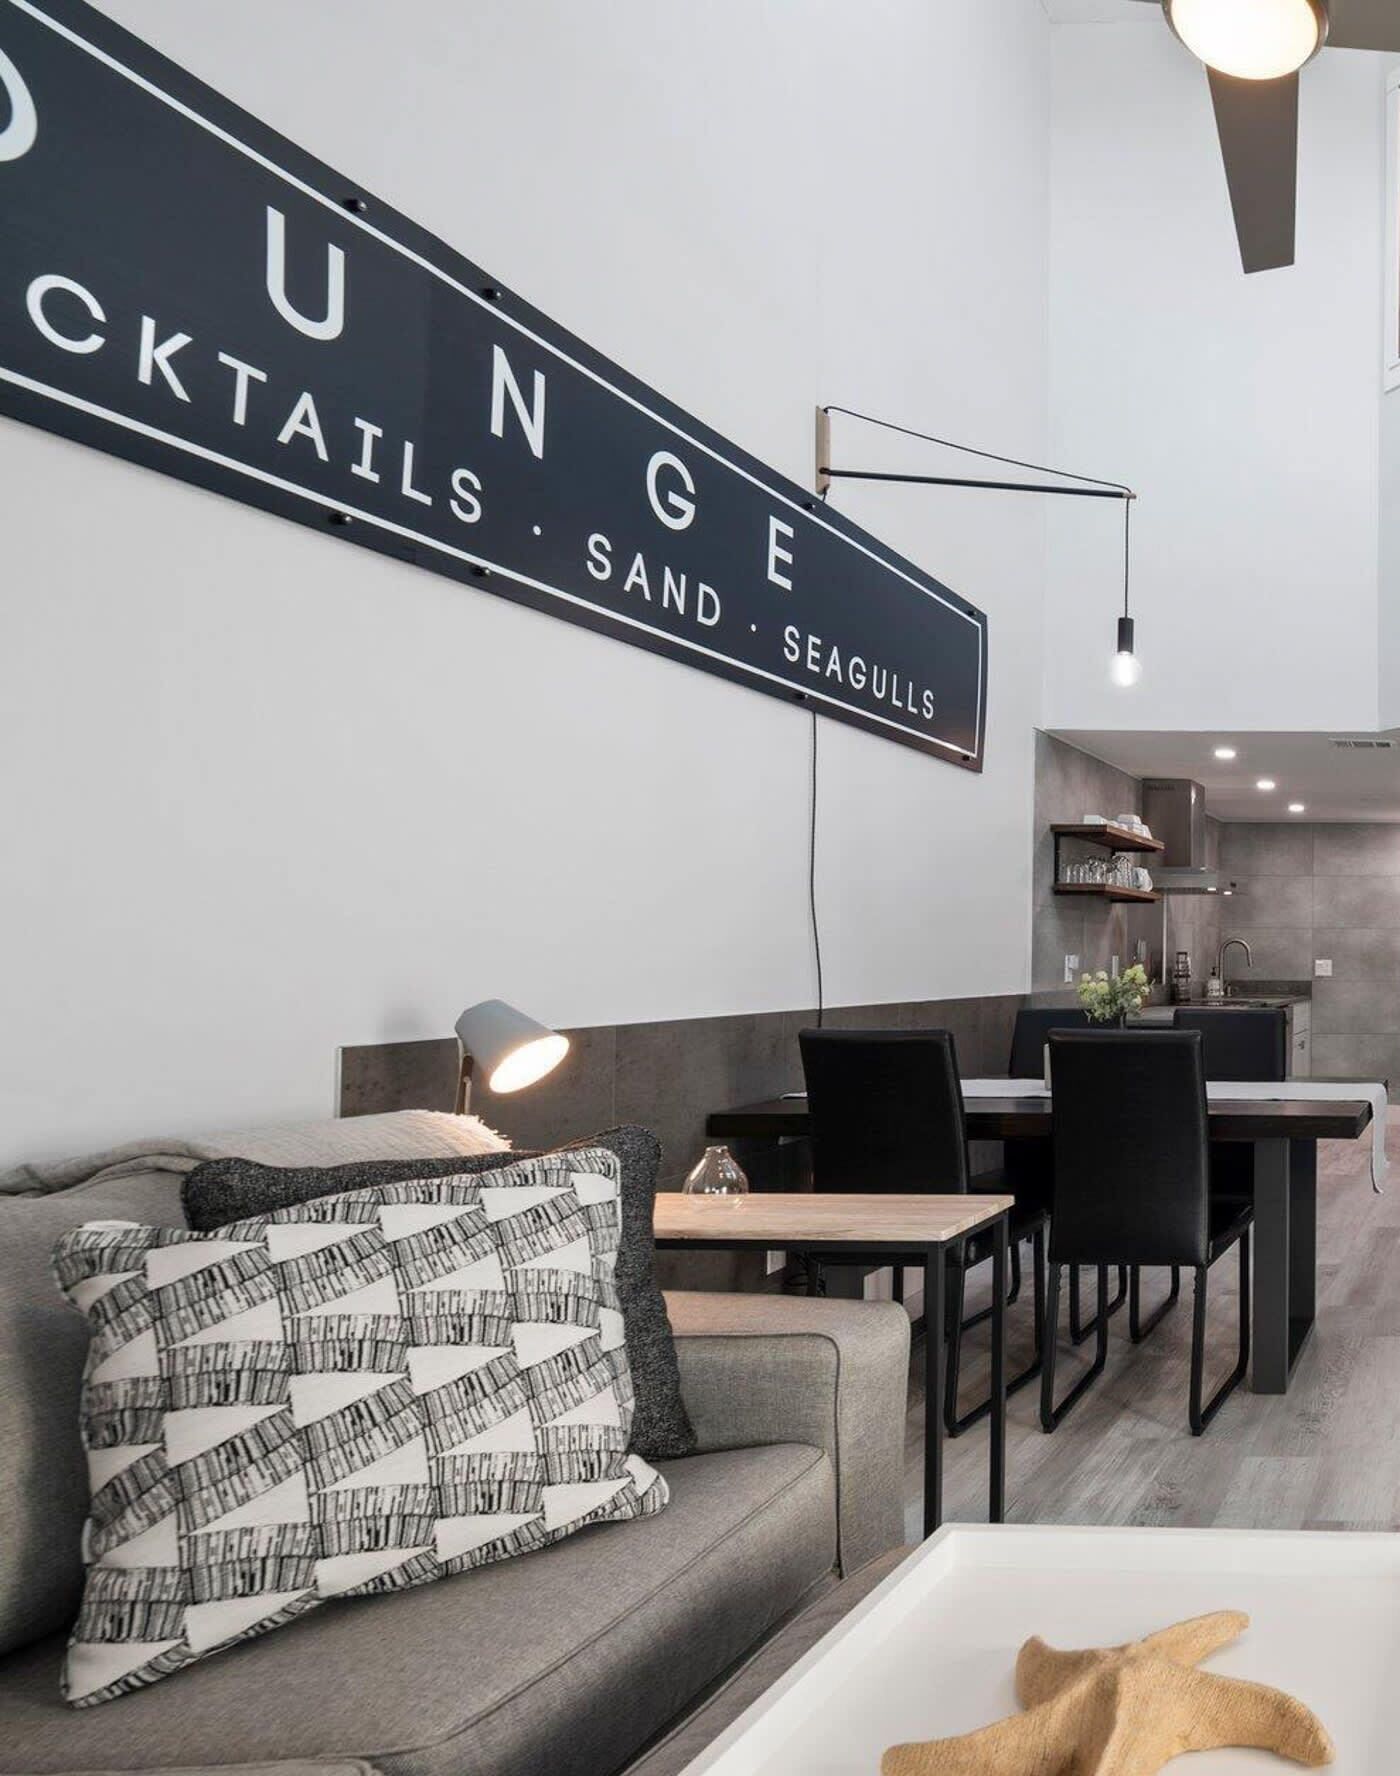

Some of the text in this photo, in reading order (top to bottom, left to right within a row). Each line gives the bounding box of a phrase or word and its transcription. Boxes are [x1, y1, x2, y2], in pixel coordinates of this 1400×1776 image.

[0, 48, 794, 592] UNGE
[586, 532, 721, 627] SAND
[783, 625, 935, 720] SEAGULLS
